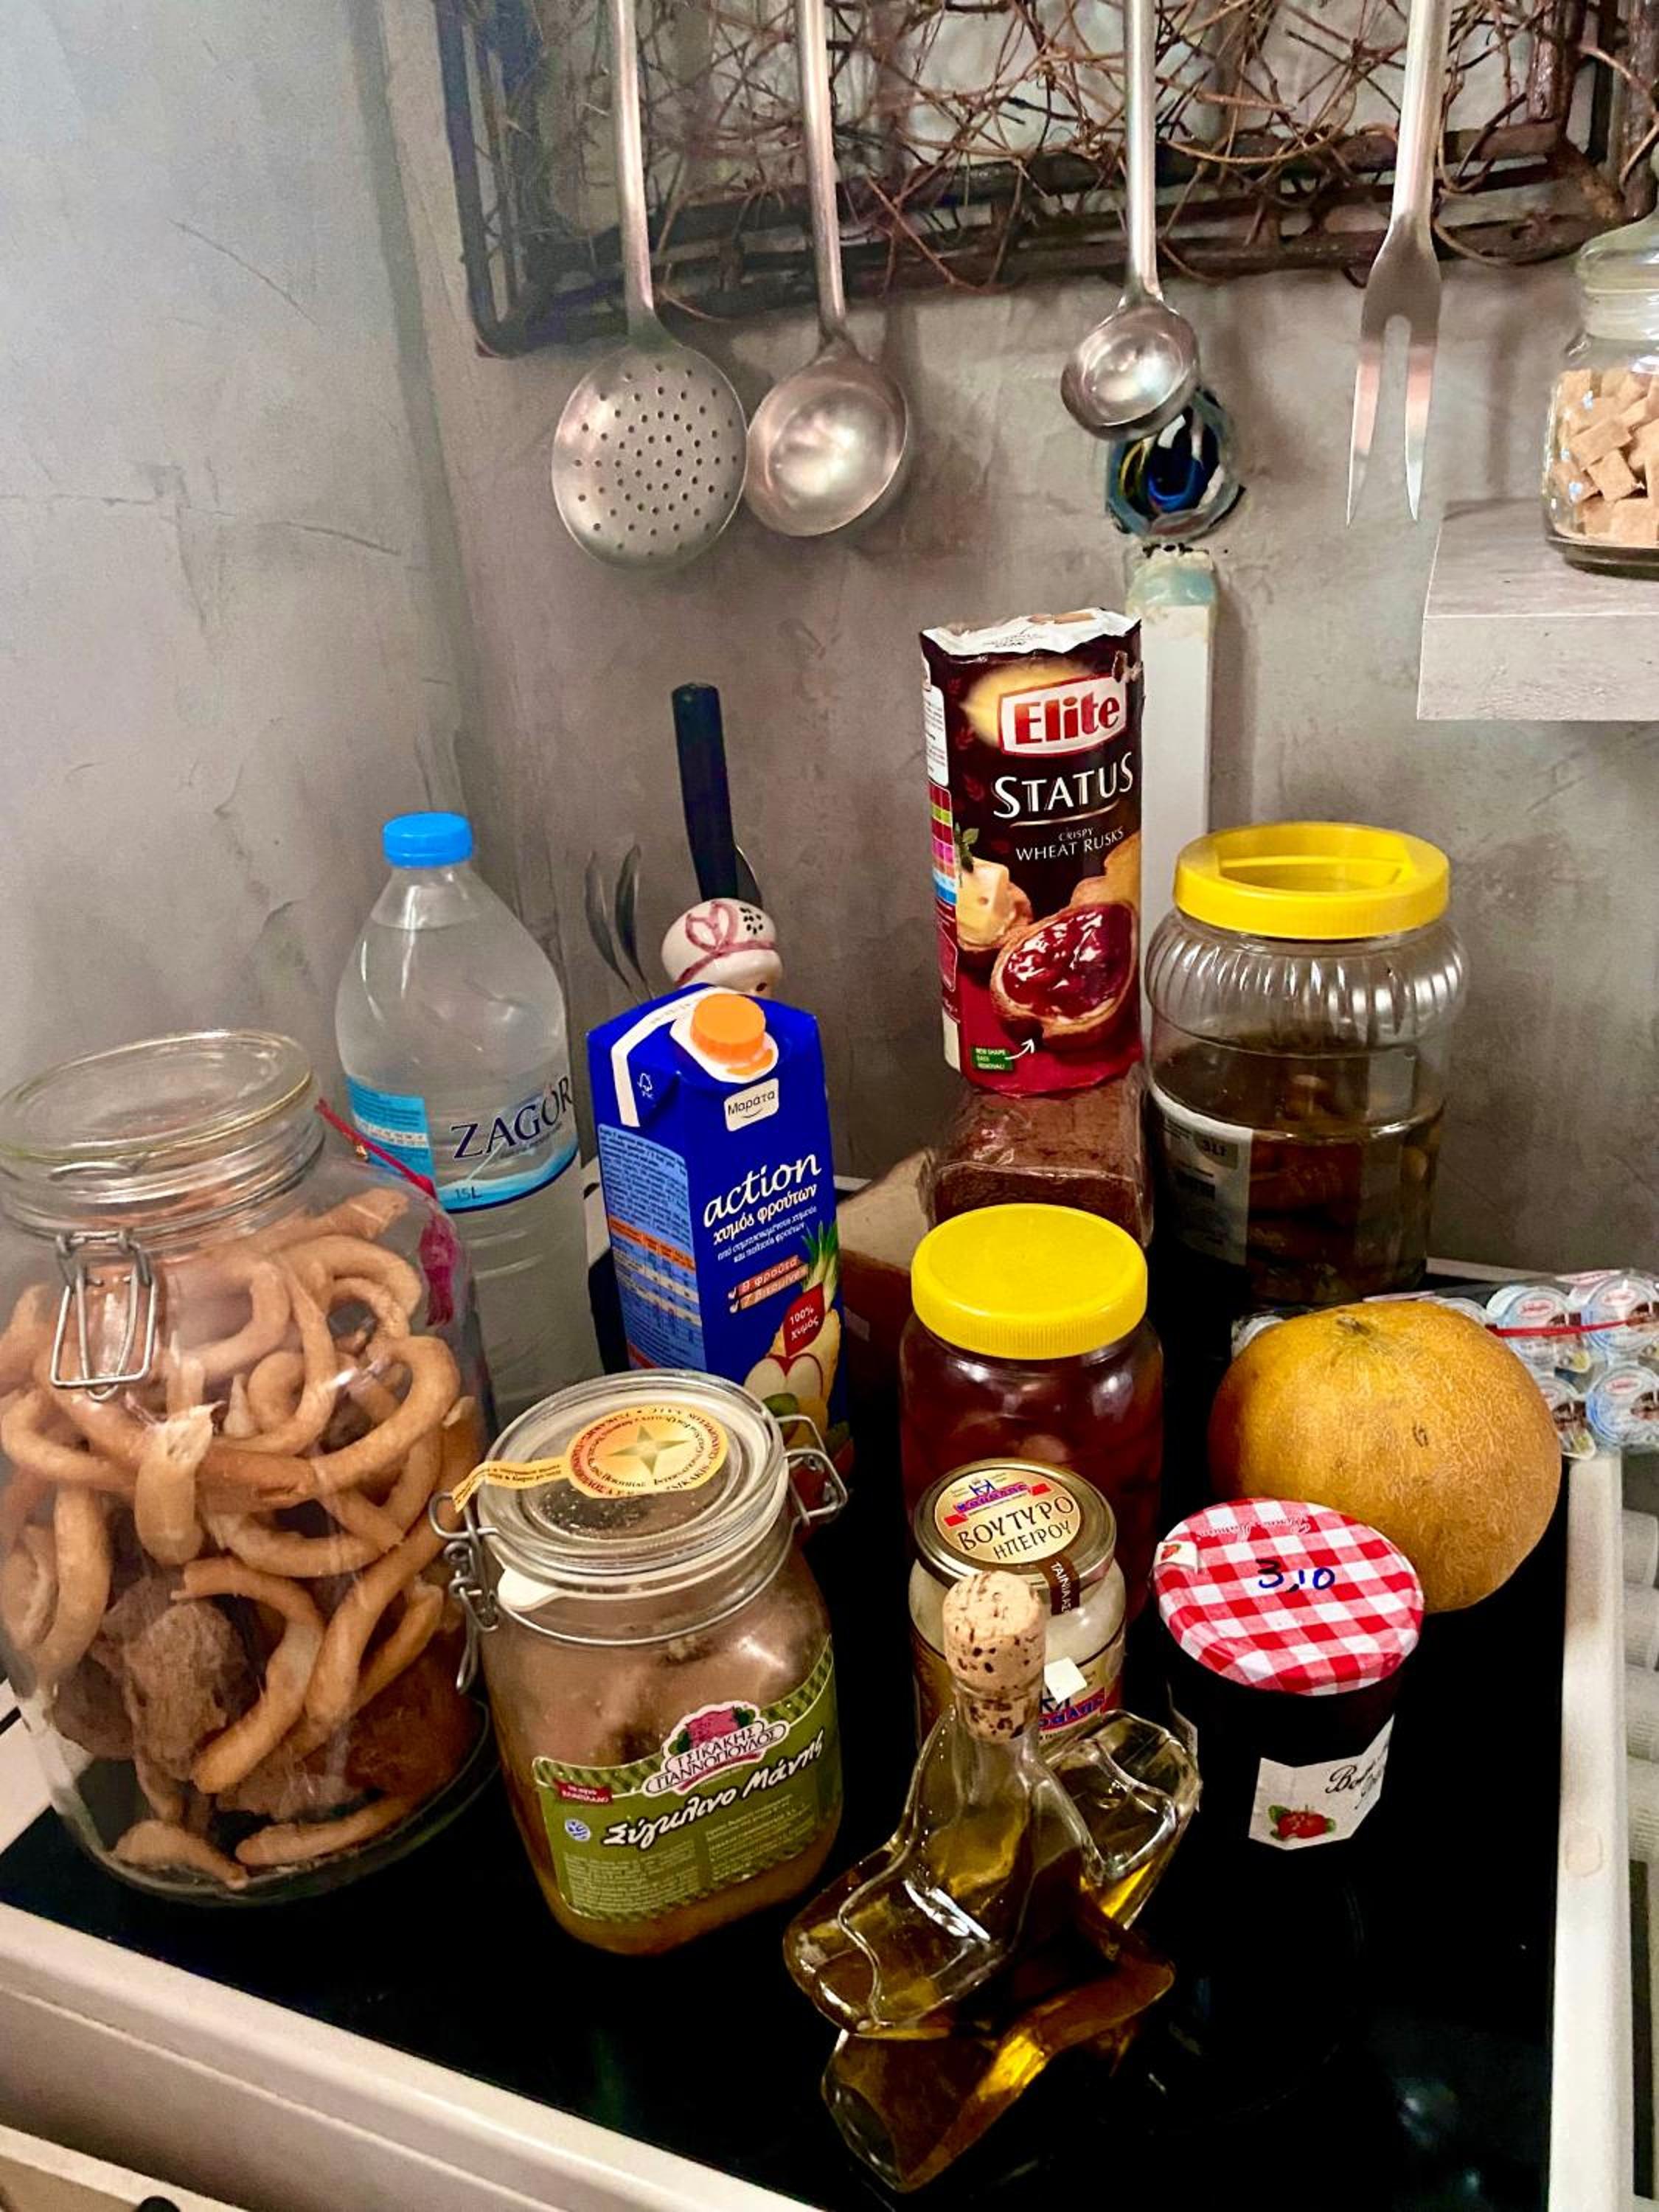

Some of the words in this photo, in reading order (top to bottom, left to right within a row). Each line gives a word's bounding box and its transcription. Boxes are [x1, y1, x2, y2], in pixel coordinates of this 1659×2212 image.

[1013, 690, 1121, 745] Elite
[992, 751, 1134, 818] STATUS
[1015, 842, 1079, 861] WHEAT
[1084, 827, 1125, 853] RUSKS
[1058, 827, 1094, 842] CRISPY
[703, 1154, 821, 1228] action
[713, 1212, 755, 1245] χυμός
[757, 1183, 817, 1224] φρούτων
[790, 1304, 815, 1325] 100%
[958, 1496, 1074, 1551] ΒΟΥΤΥΡΟ
[992, 1520, 1071, 1560] ΗΠΕΙΡΟΥ
[655, 1730, 777, 1790] ΓΙΑΝΝΟΠΟΥΛΟΣ
[677, 1728, 757, 1768] ΤΣΙΚΑΚΗΣ
[602, 1787, 737, 1848] Σύγκλινο
